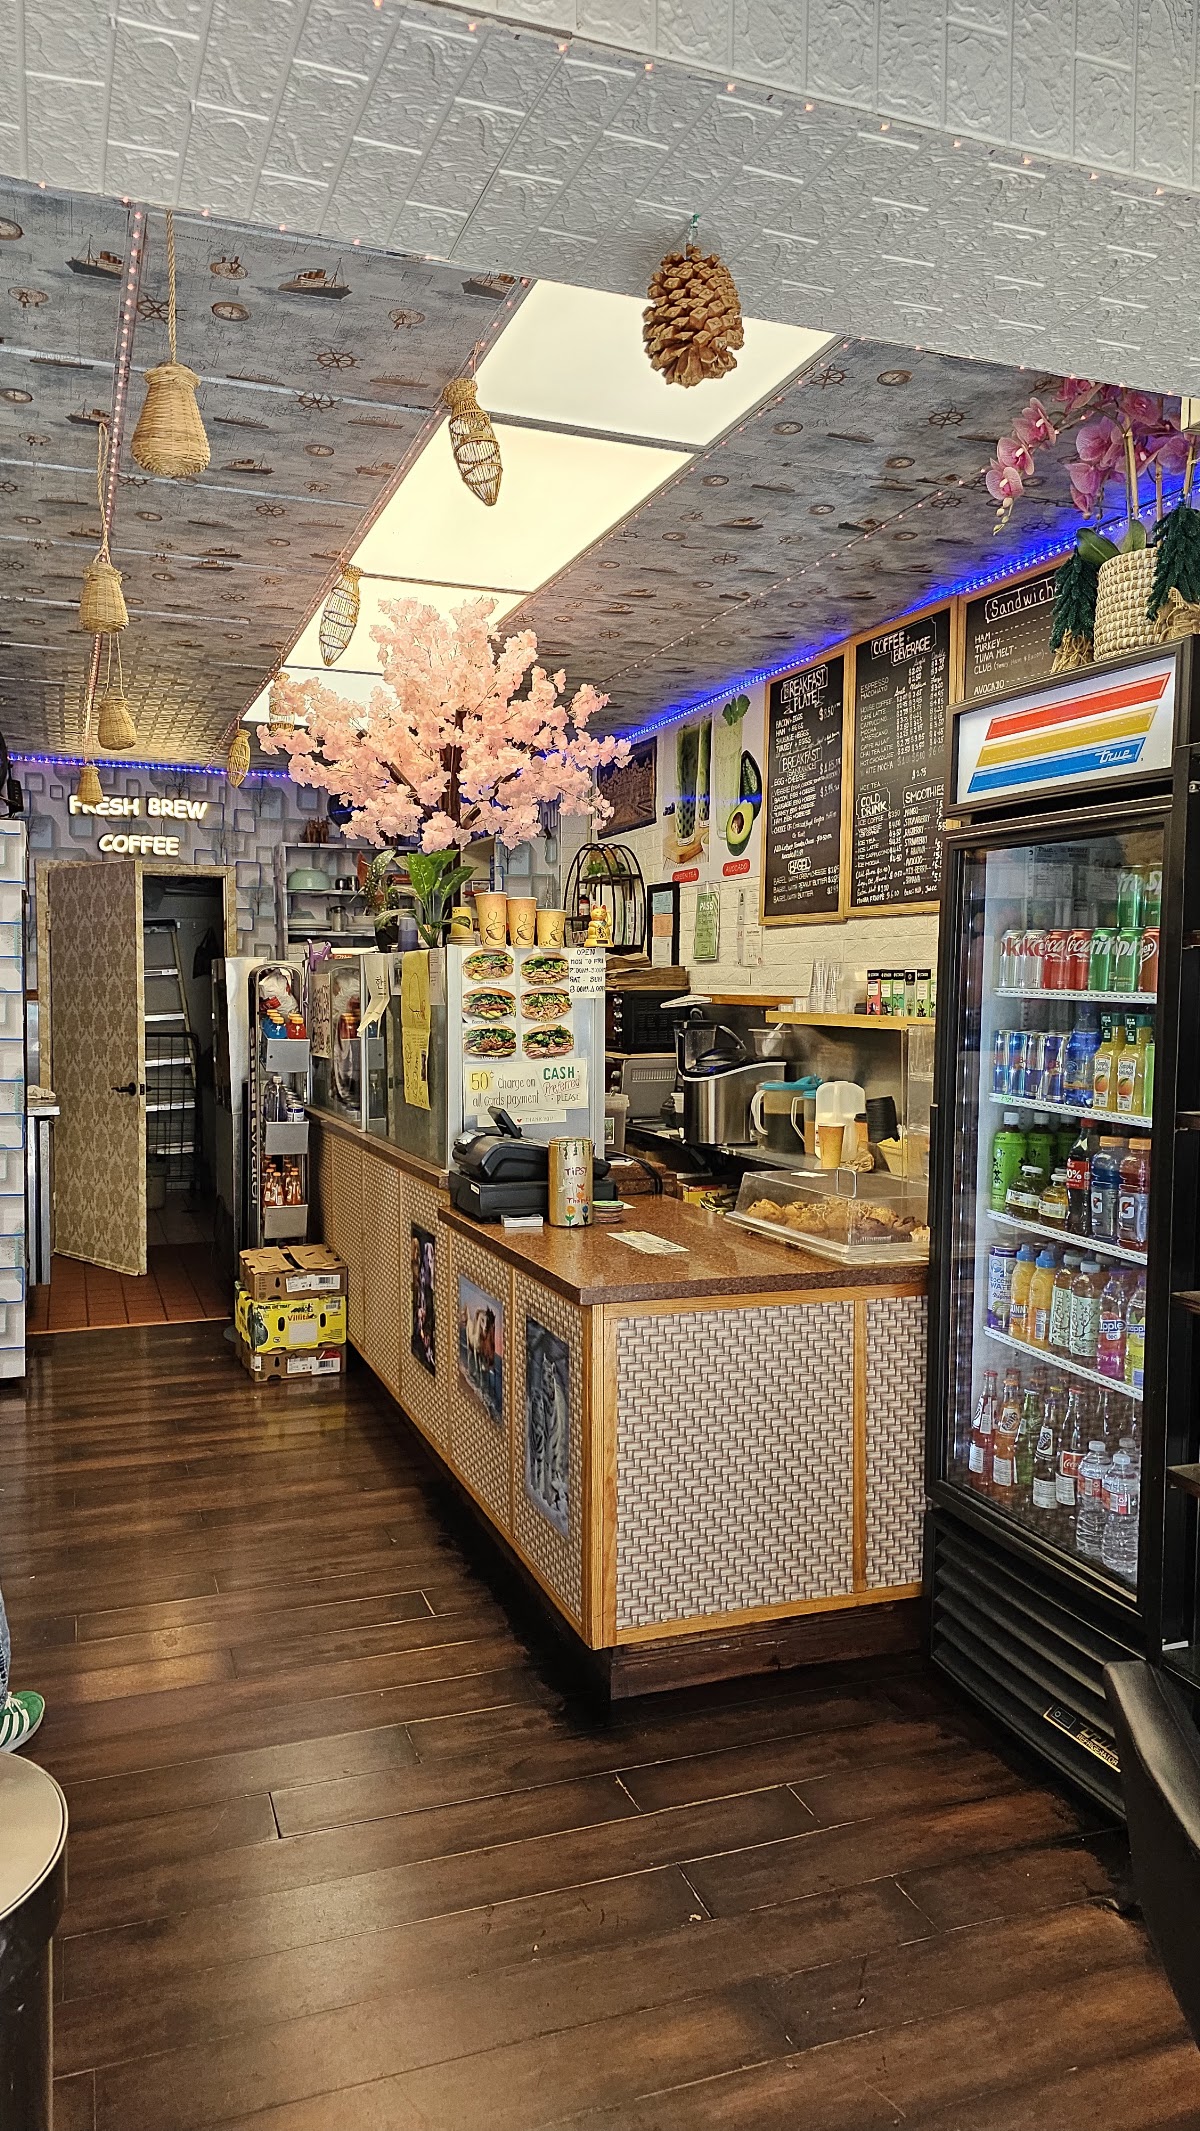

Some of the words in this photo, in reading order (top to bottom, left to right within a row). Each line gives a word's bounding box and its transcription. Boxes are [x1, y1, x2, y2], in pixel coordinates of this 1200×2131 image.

[874, 631, 905, 655] COFFEE
[975, 632, 991, 644] HAM
[975, 638, 1001, 653] TURKEY
[893, 636, 931, 663] BEVERAGE
[975, 652, 994, 664] TUNA
[996, 645, 1014, 659] MELT
[974, 663, 992, 675] CLUB
[784, 669, 826, 700] BREAKFAST
[860, 676, 889, 694] ESPRESSO
[794, 689, 818, 712] PLATE
[782, 747, 821, 771] BREAKFAST
[861, 793, 880, 807] COLD
[147, 798, 208, 820] BREW
[861, 801, 887, 818] DRINK
[867, 815, 884, 825] COFFEE
[98, 833, 180, 857] COFFEE
[725, 862, 748, 873] AVOCADO
[790, 858, 808, 873] BAGEL
[700, 901, 714, 911] PASS
[543, 1066, 575, 1080] CASH
[498, 1075, 524, 1091] Charge
[526, 1078, 536, 1088] on
[472, 1093, 482, 1107] all
[484, 1092, 505, 1106] cards
[506, 1090, 539, 1109] payment
[1076, 1734, 1119, 1766] REFRIGERATOR
